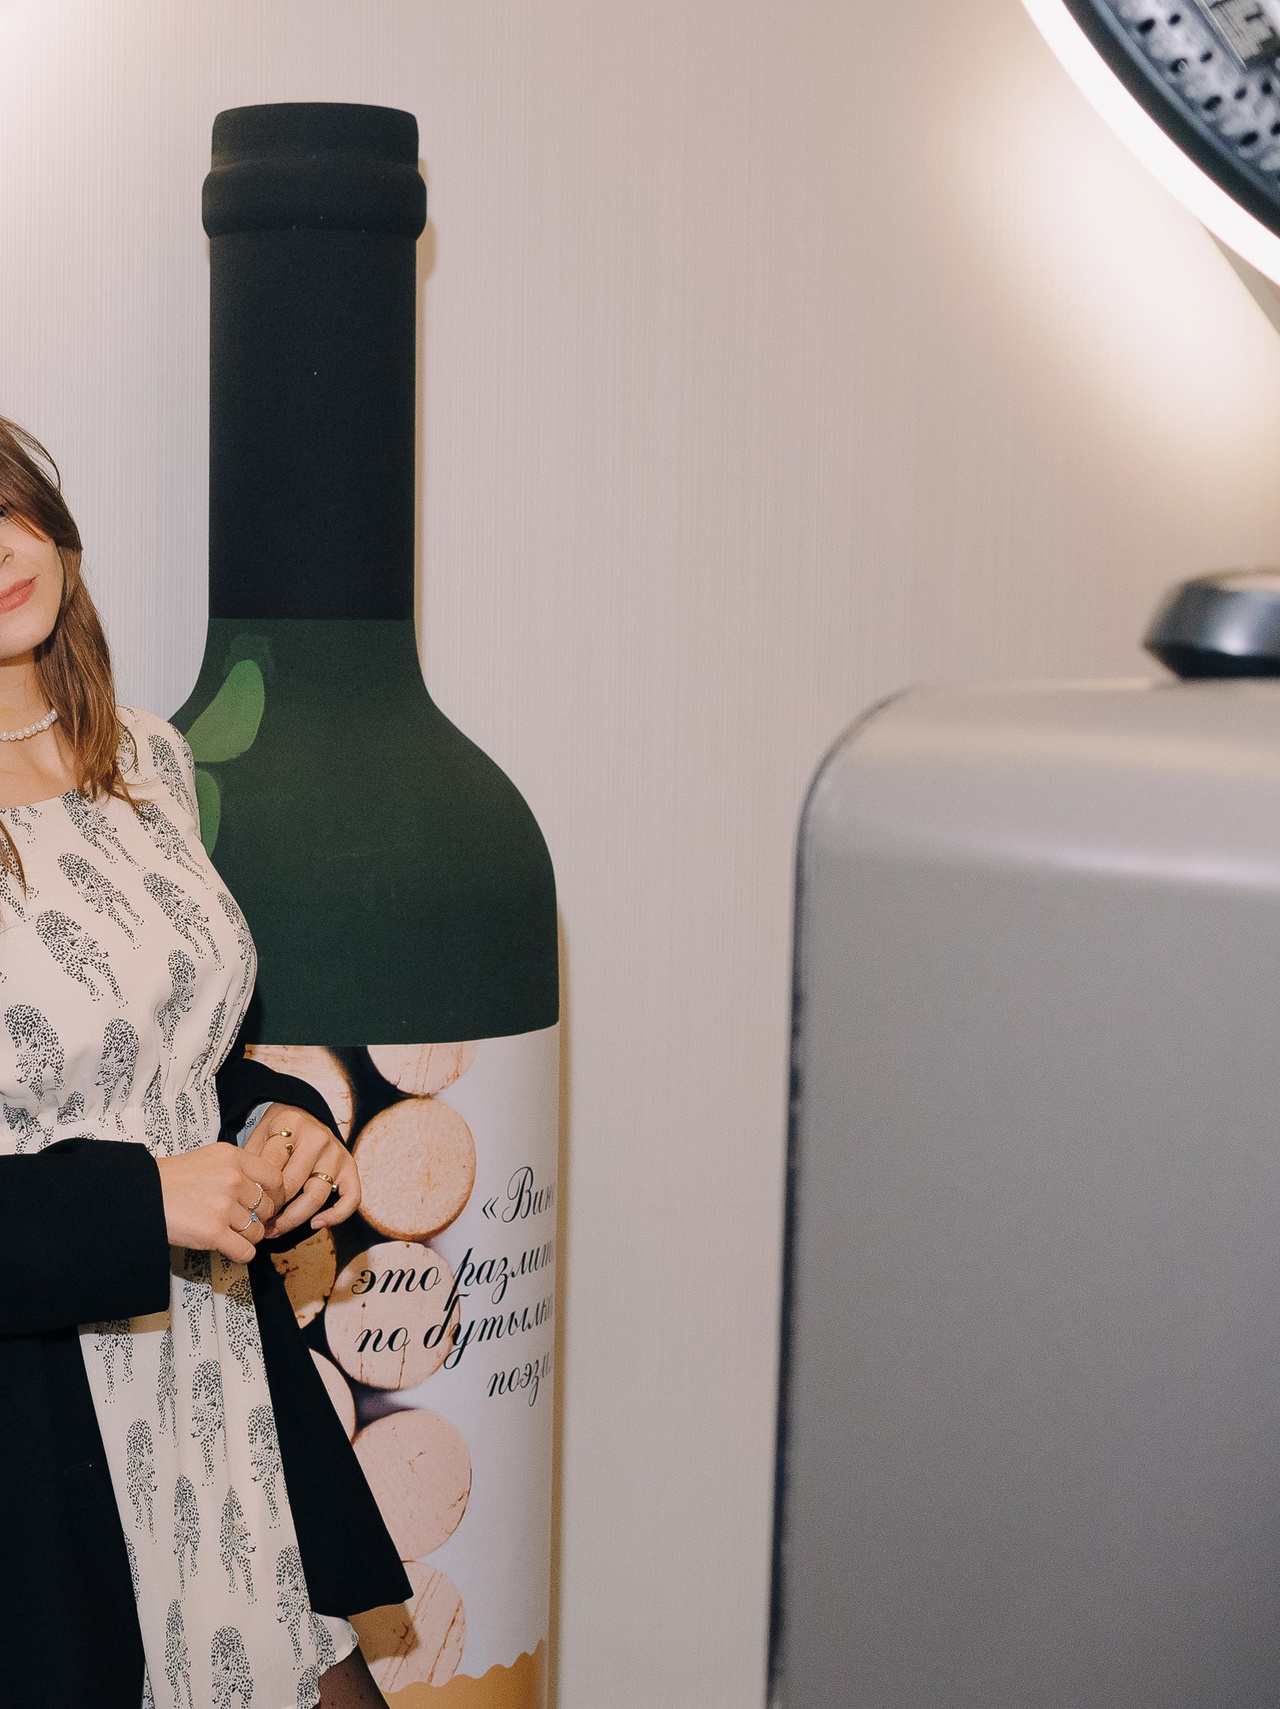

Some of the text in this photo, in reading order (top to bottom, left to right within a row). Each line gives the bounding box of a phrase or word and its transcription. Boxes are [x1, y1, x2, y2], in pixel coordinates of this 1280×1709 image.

[482, 1166, 554, 1223] «Вин
[352, 1242, 554, 1312] это разлит
[355, 1293, 553, 1370] по бутылк
[488, 1354, 552, 1407] поэзи
